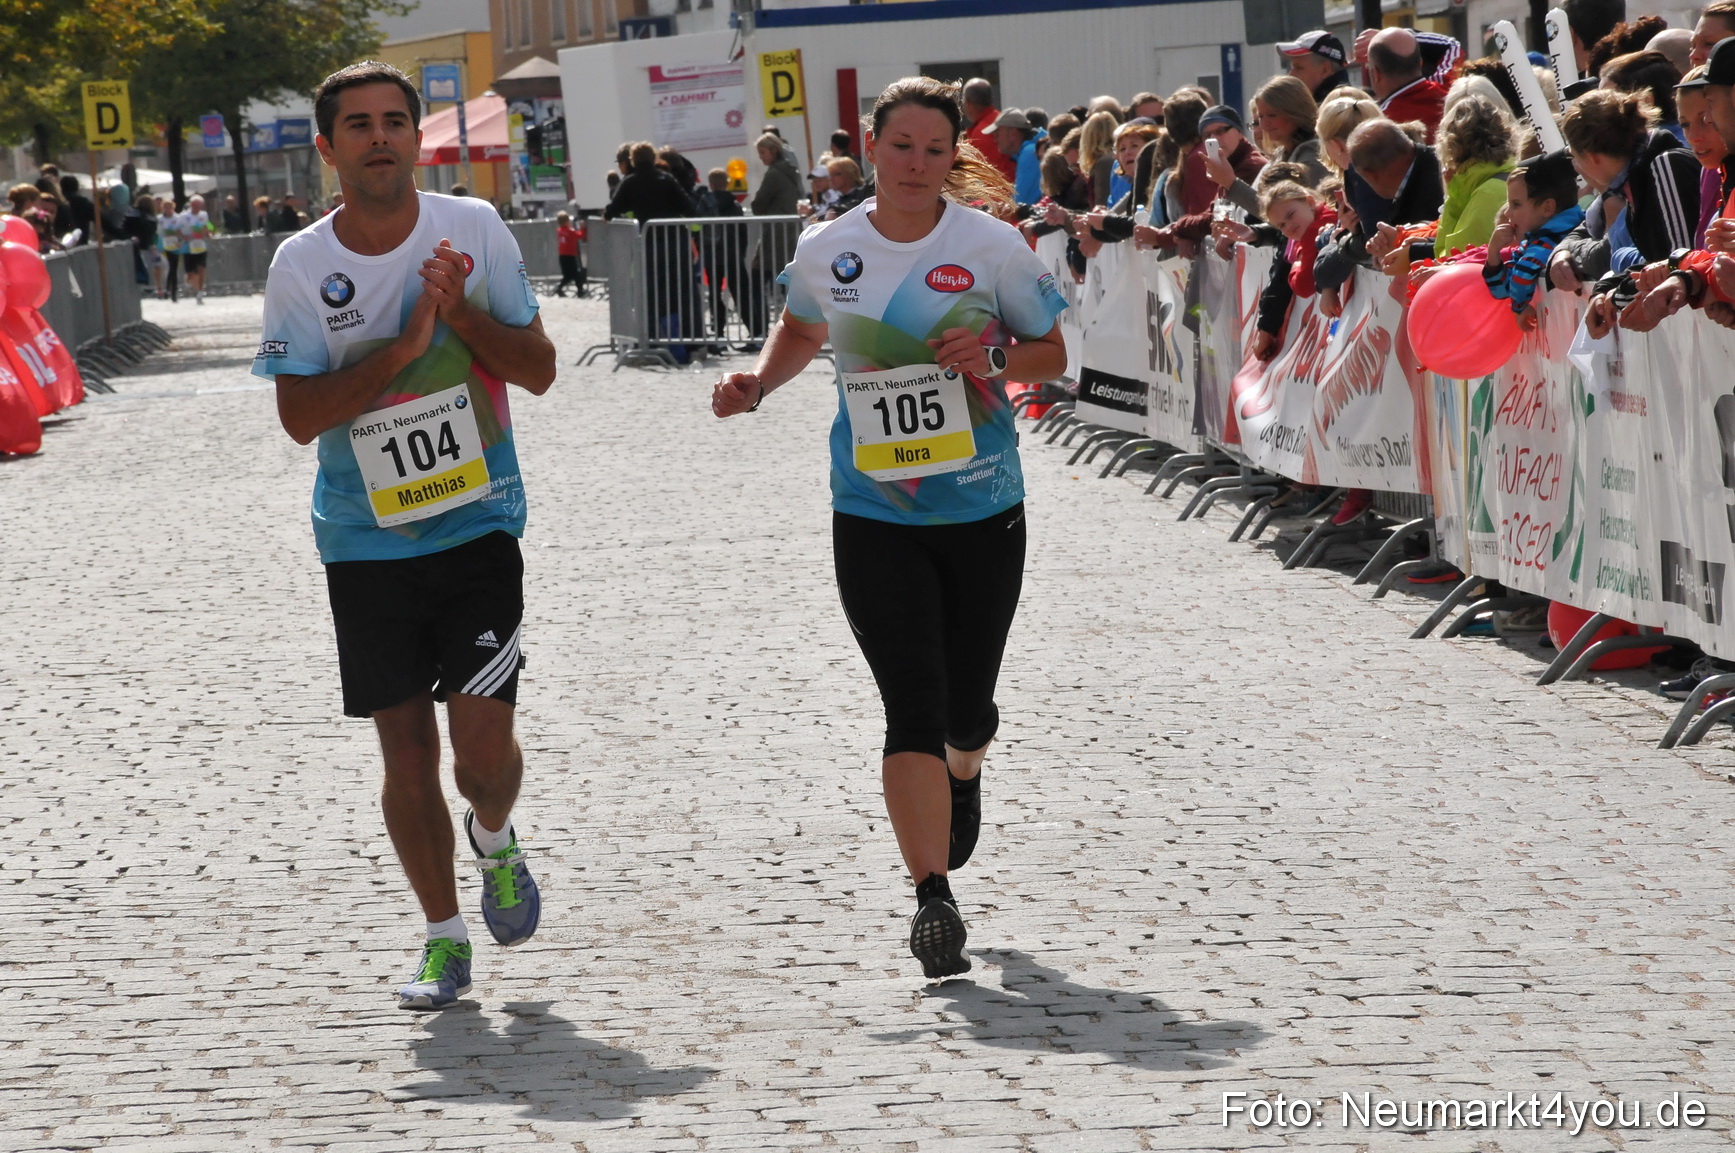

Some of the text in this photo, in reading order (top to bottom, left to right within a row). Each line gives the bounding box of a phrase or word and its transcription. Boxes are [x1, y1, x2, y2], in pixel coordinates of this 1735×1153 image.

[763, 51, 797, 67] Block
[87, 84, 123, 97] Block
[772, 70, 795, 103] D
[96, 102, 119, 134] D
[932, 271, 968, 287] Hervis
[831, 287, 860, 297] PARTL
[326, 309, 364, 326] PARTL
[330, 318, 365, 333] Neumarkt
[847, 372, 940, 393] PARTL Neumarkt
[873, 389, 945, 436] 105
[351, 403, 452, 440] PARTL Neumarkt
[380, 420, 461, 478] 104
[894, 447, 931, 463] Nora
[490, 474, 519, 489] arkter
[956, 465, 997, 486] Stadtlauf
[397, 475, 466, 507] Matthias
[475, 640, 500, 649] adidas
